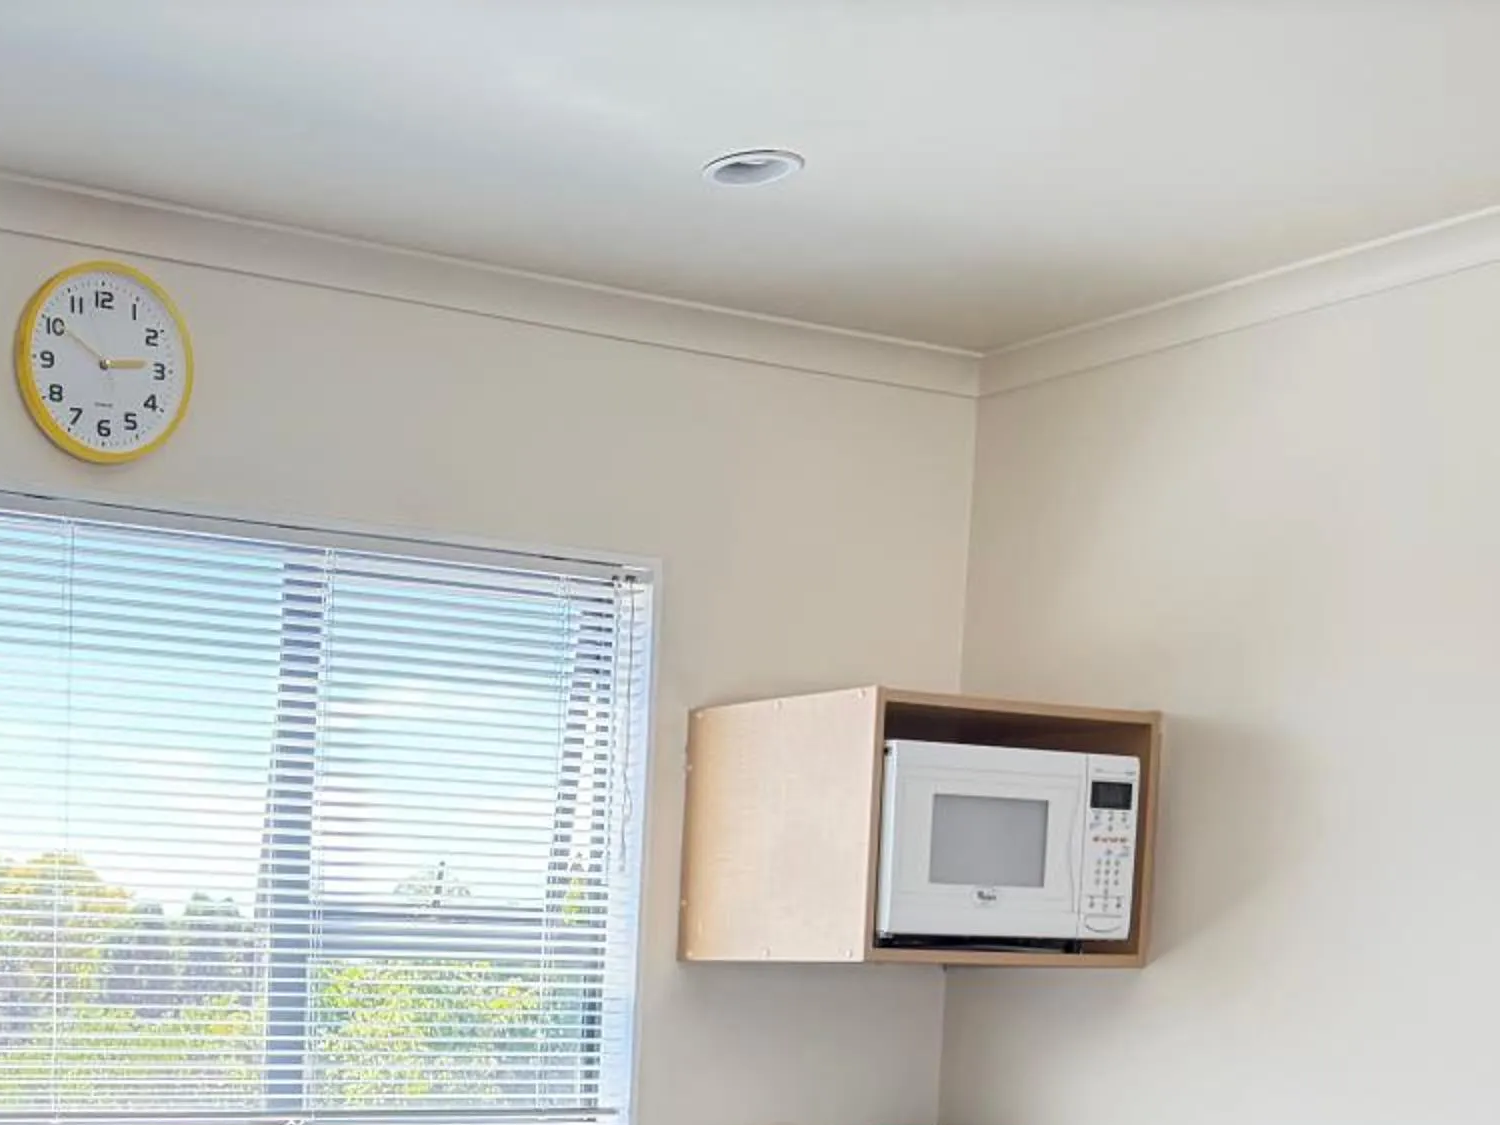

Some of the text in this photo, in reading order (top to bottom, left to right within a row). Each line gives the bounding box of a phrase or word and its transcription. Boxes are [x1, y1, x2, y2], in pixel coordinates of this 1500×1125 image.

[71, 295, 83, 315] 11
[95, 290, 114, 310] 12
[132, 303, 137, 320] 1
[46, 317, 65, 336] 10
[145, 328, 159, 346] 2
[40, 350, 55, 368] 9
[153, 363, 166, 381] 3
[48, 384, 64, 402] 8
[143, 394, 158, 412] 4
[69, 407, 83, 425] 7
[124, 413, 138, 431] 5
[97, 420, 111, 437] 6
